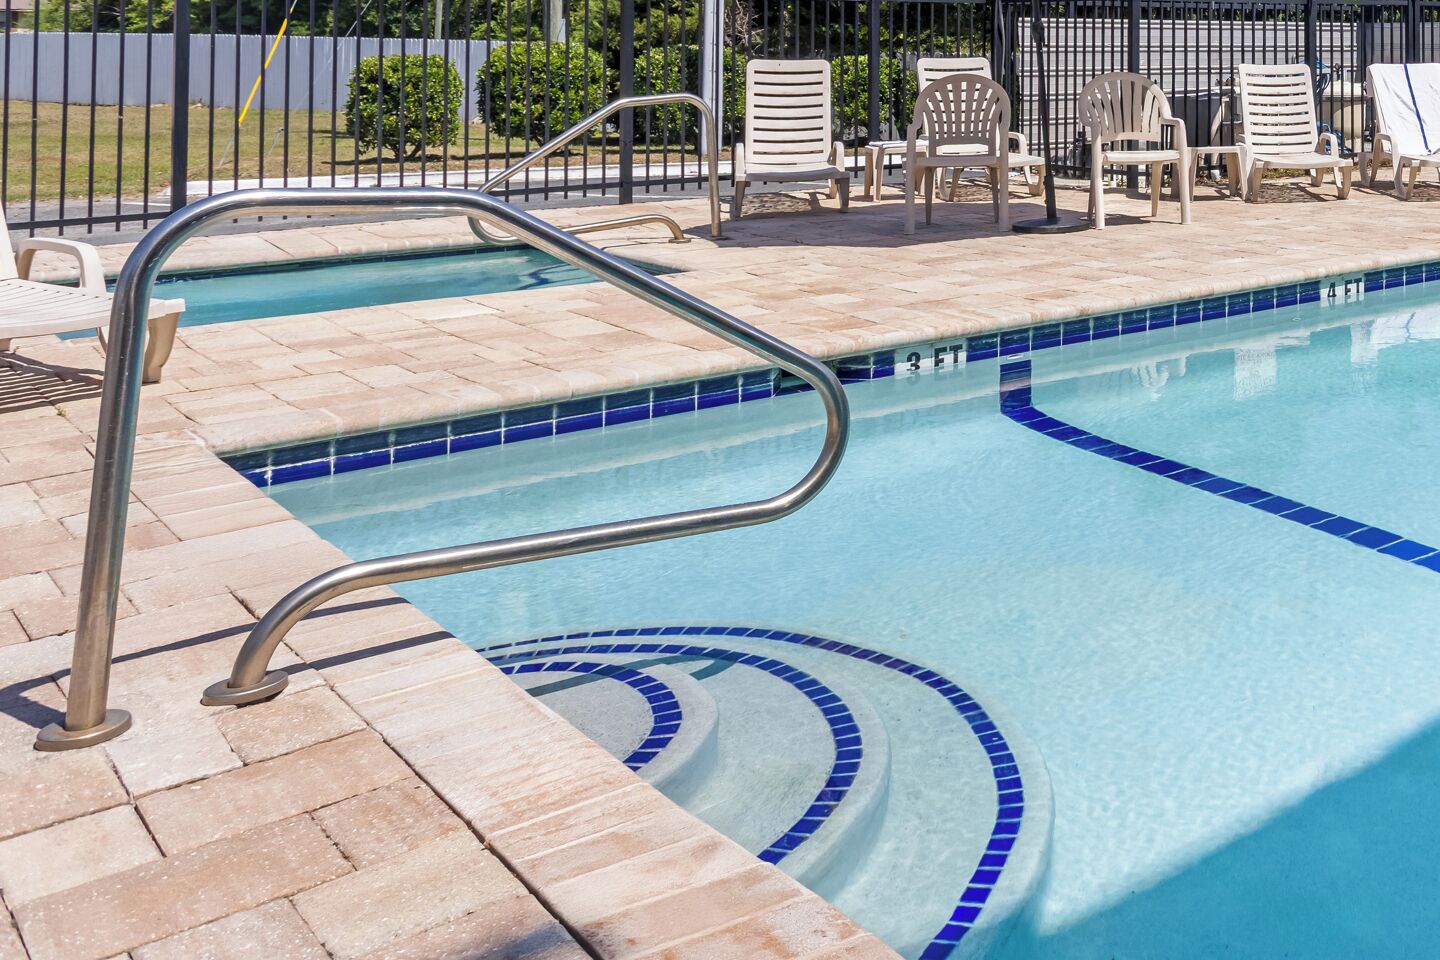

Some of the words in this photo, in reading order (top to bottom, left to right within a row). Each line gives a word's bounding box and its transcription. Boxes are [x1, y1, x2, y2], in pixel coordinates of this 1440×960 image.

[1327, 281, 1337, 298] 4
[1344, 277, 1363, 296] FT
[906, 351, 921, 372] 3
[933, 343, 964, 368] FT
